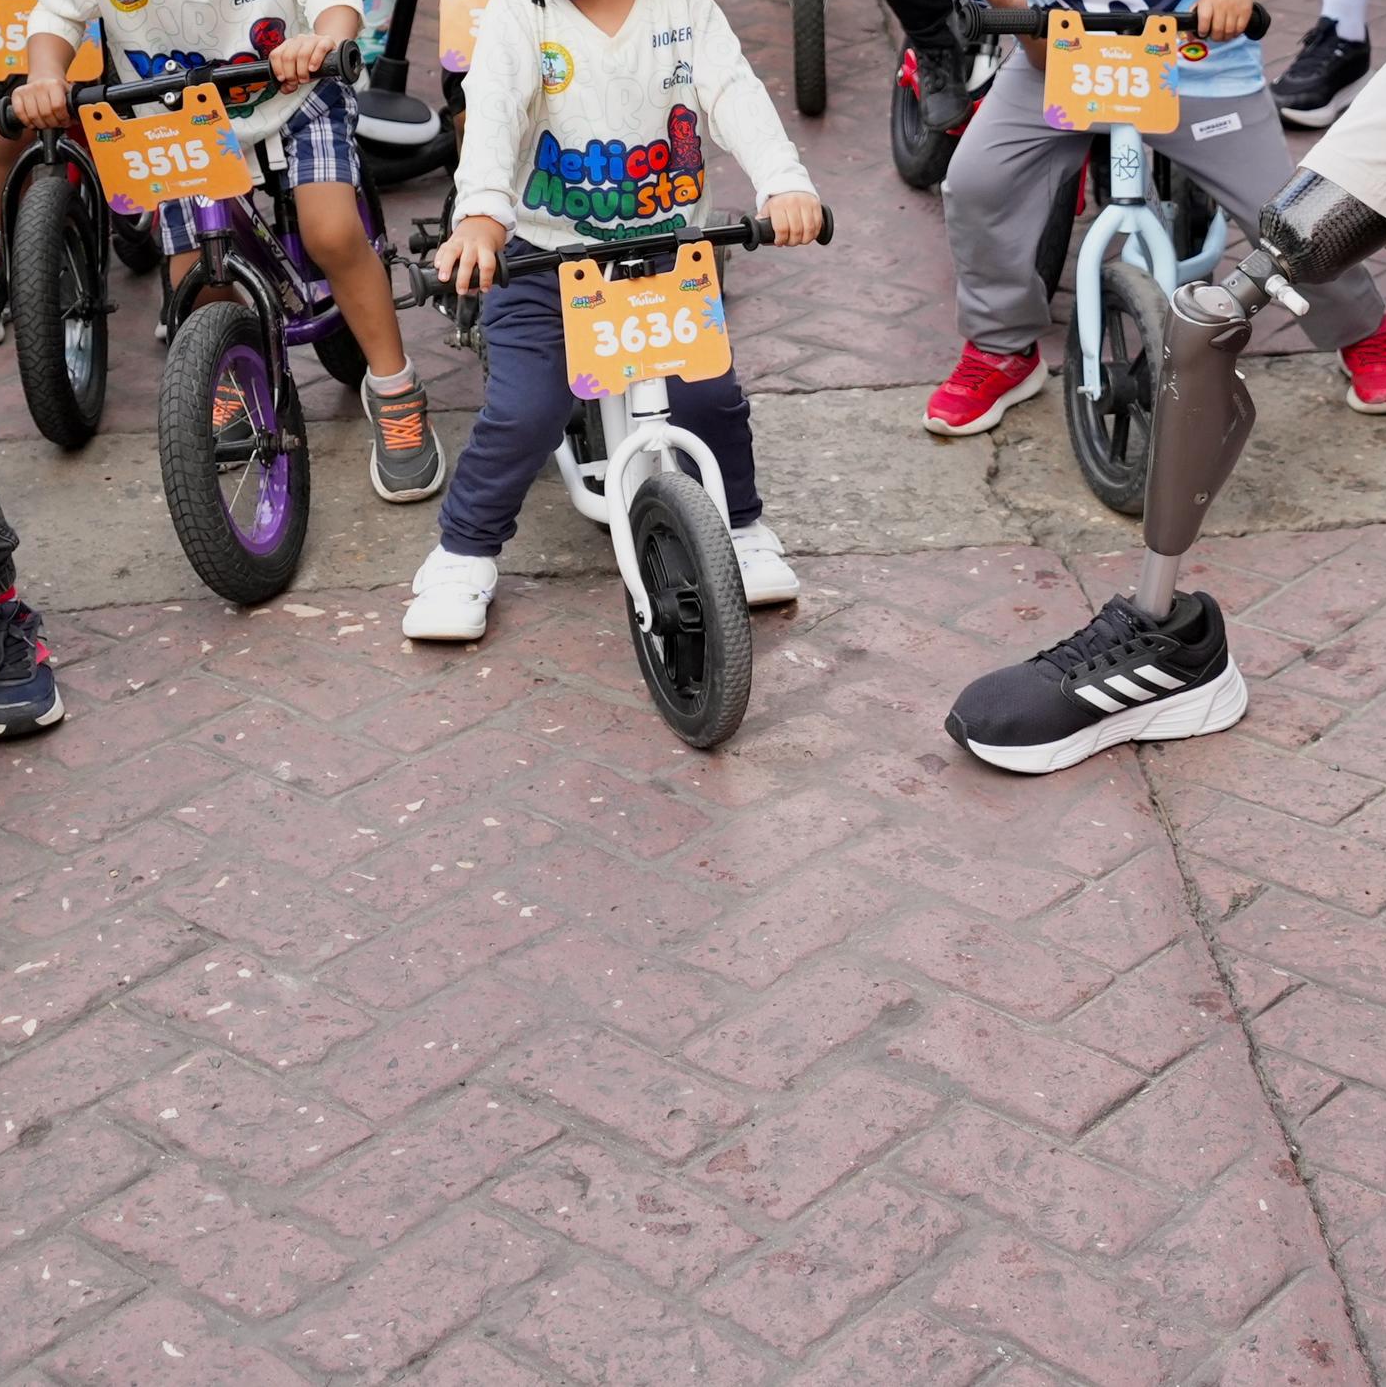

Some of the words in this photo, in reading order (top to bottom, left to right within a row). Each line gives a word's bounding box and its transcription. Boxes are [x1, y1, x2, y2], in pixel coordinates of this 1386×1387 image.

[1071, 63, 1150, 98] 3513
[123, 138, 210, 181] 3515
[533, 129, 671, 184] Retico
[592, 306, 698, 358] 3636
